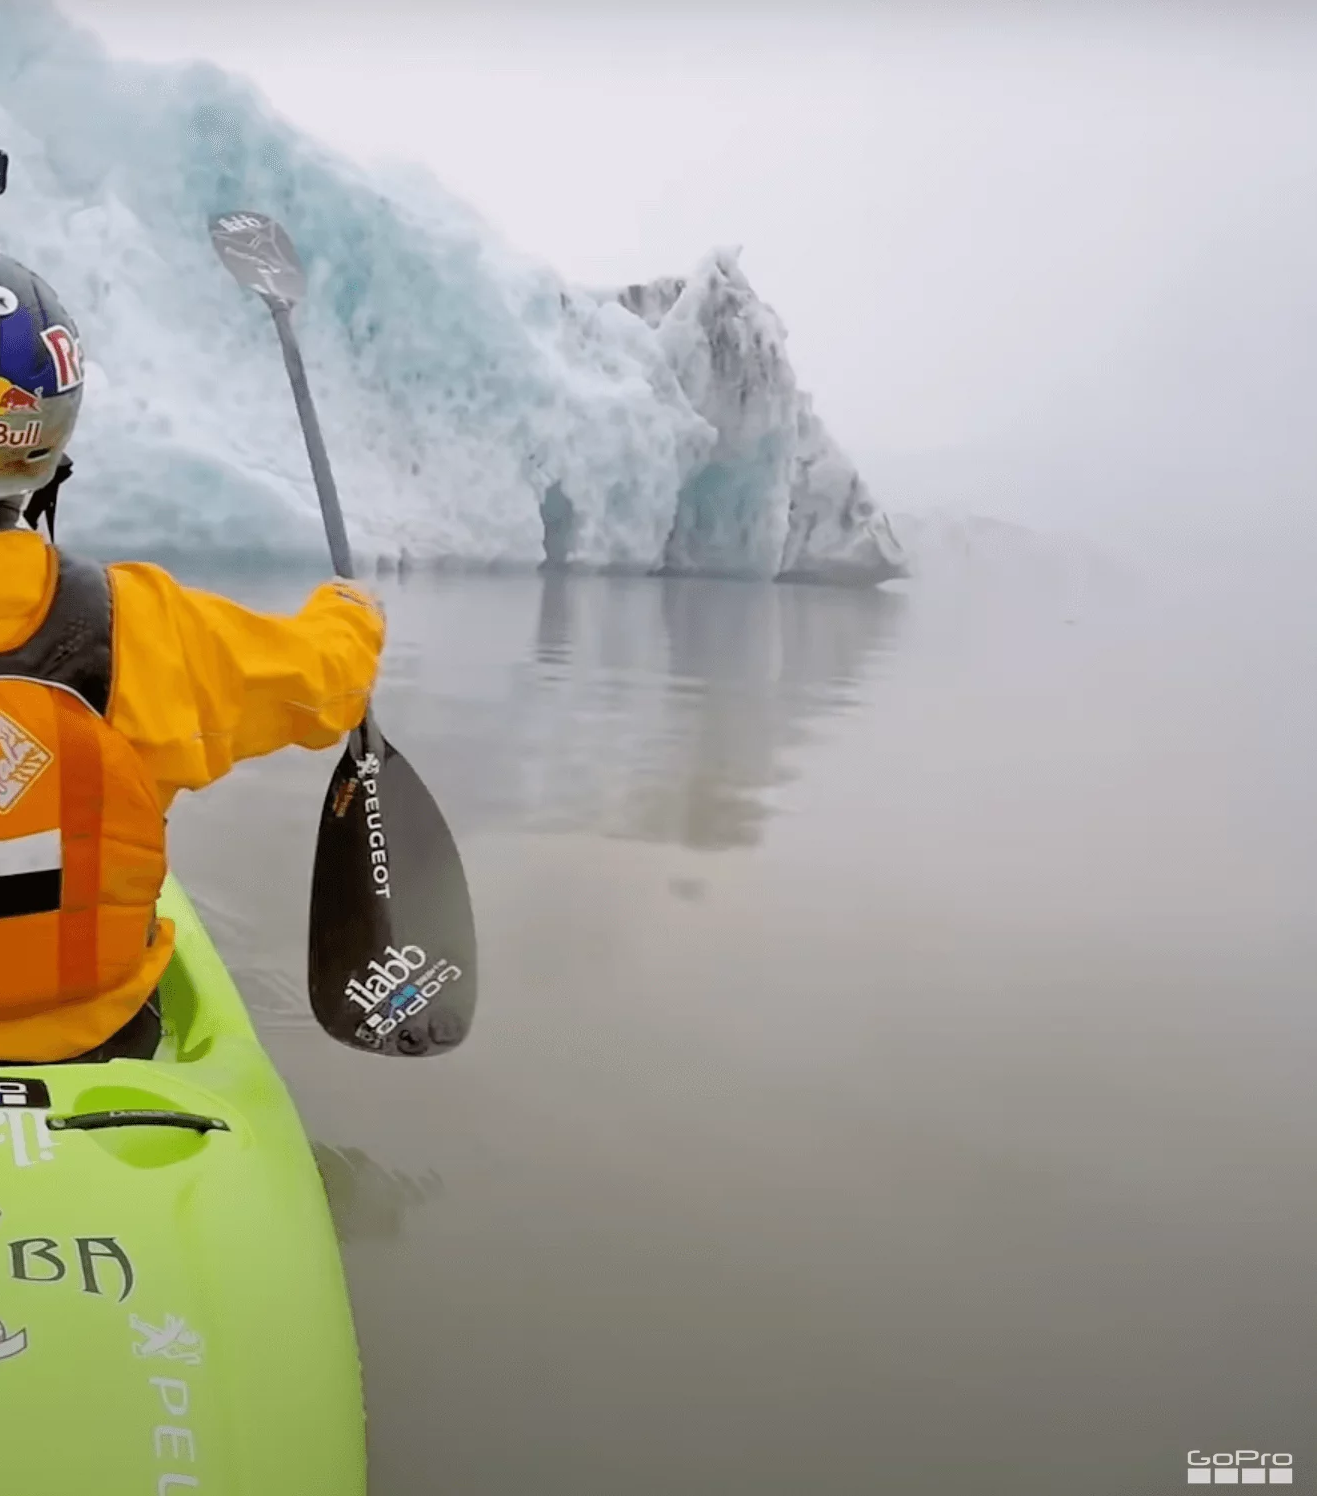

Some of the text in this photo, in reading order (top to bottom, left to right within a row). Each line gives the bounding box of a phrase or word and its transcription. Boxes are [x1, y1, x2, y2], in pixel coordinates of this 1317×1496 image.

[363, 779, 391, 899] PEUGEOT
[344, 945, 426, 1013] ilabb
[375, 965, 462, 1035] GoPro
